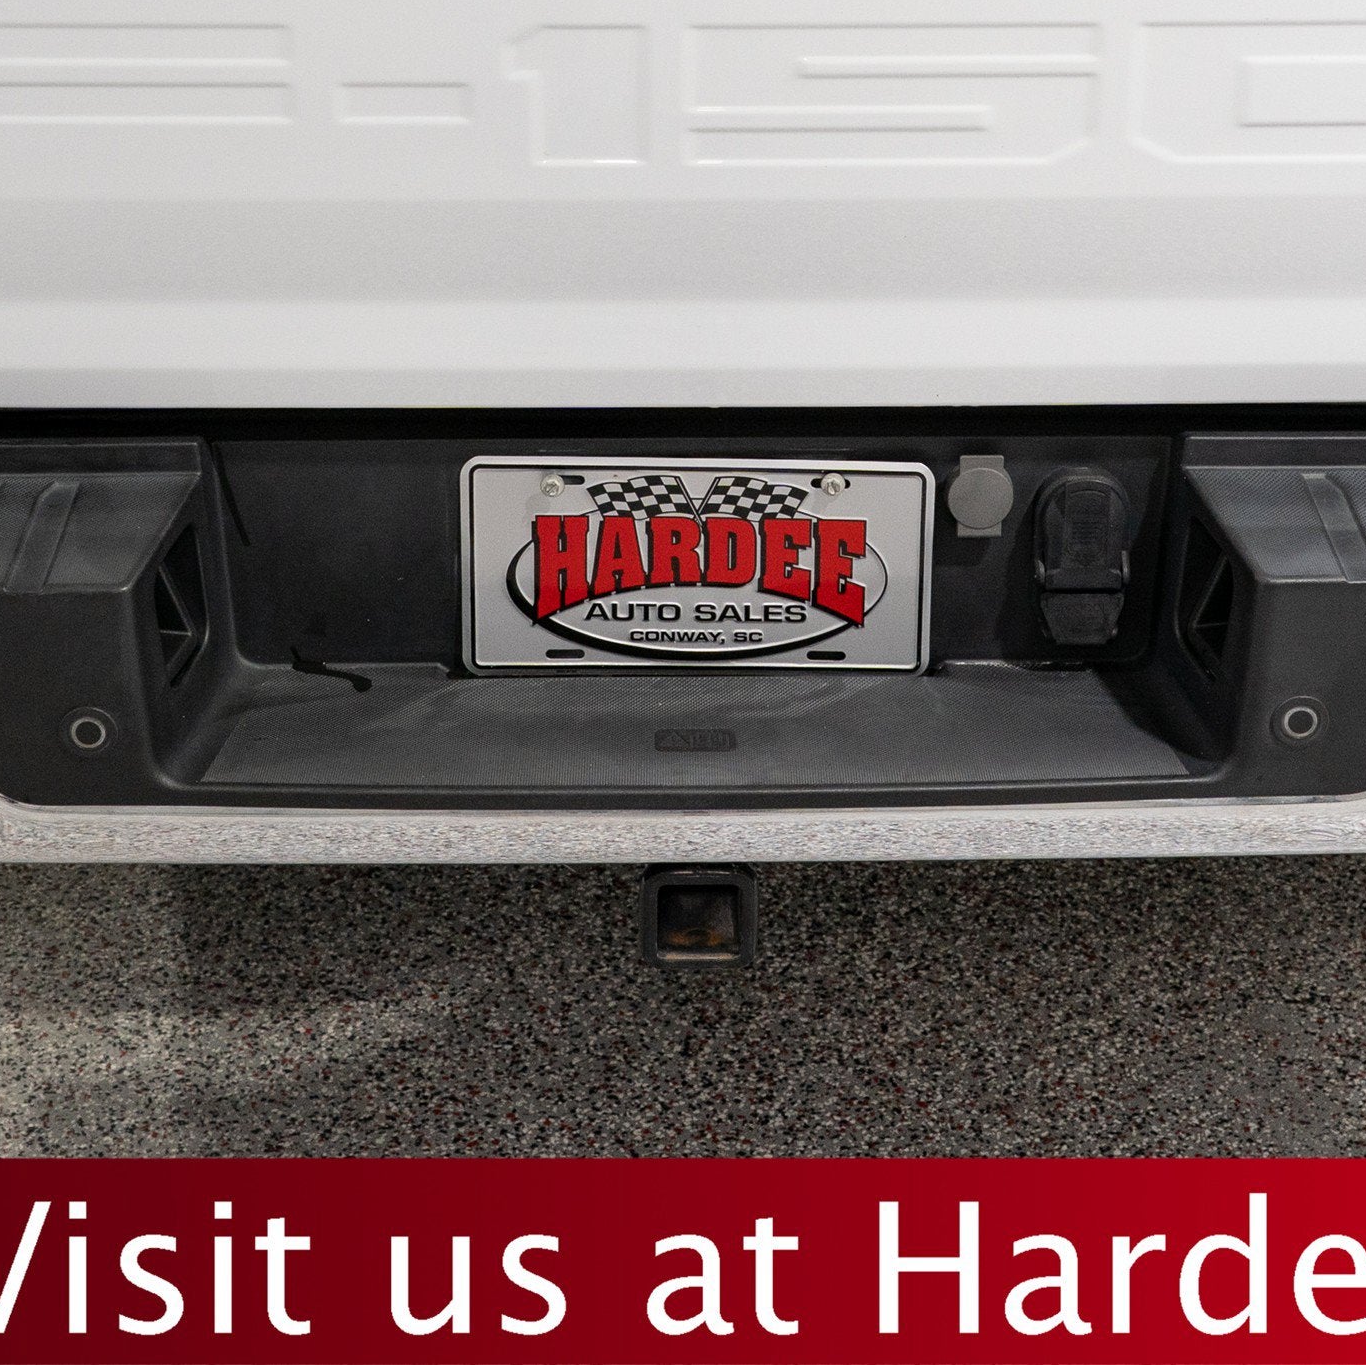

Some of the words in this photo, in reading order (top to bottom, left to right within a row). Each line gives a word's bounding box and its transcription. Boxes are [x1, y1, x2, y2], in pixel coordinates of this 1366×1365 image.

[531, 515, 868, 627] HARDEE
[585, 602, 682, 622] AUTO
[694, 603, 807, 623] SALES
[630, 630, 726, 644] CONWAY,
[733, 631, 763, 643] SC
